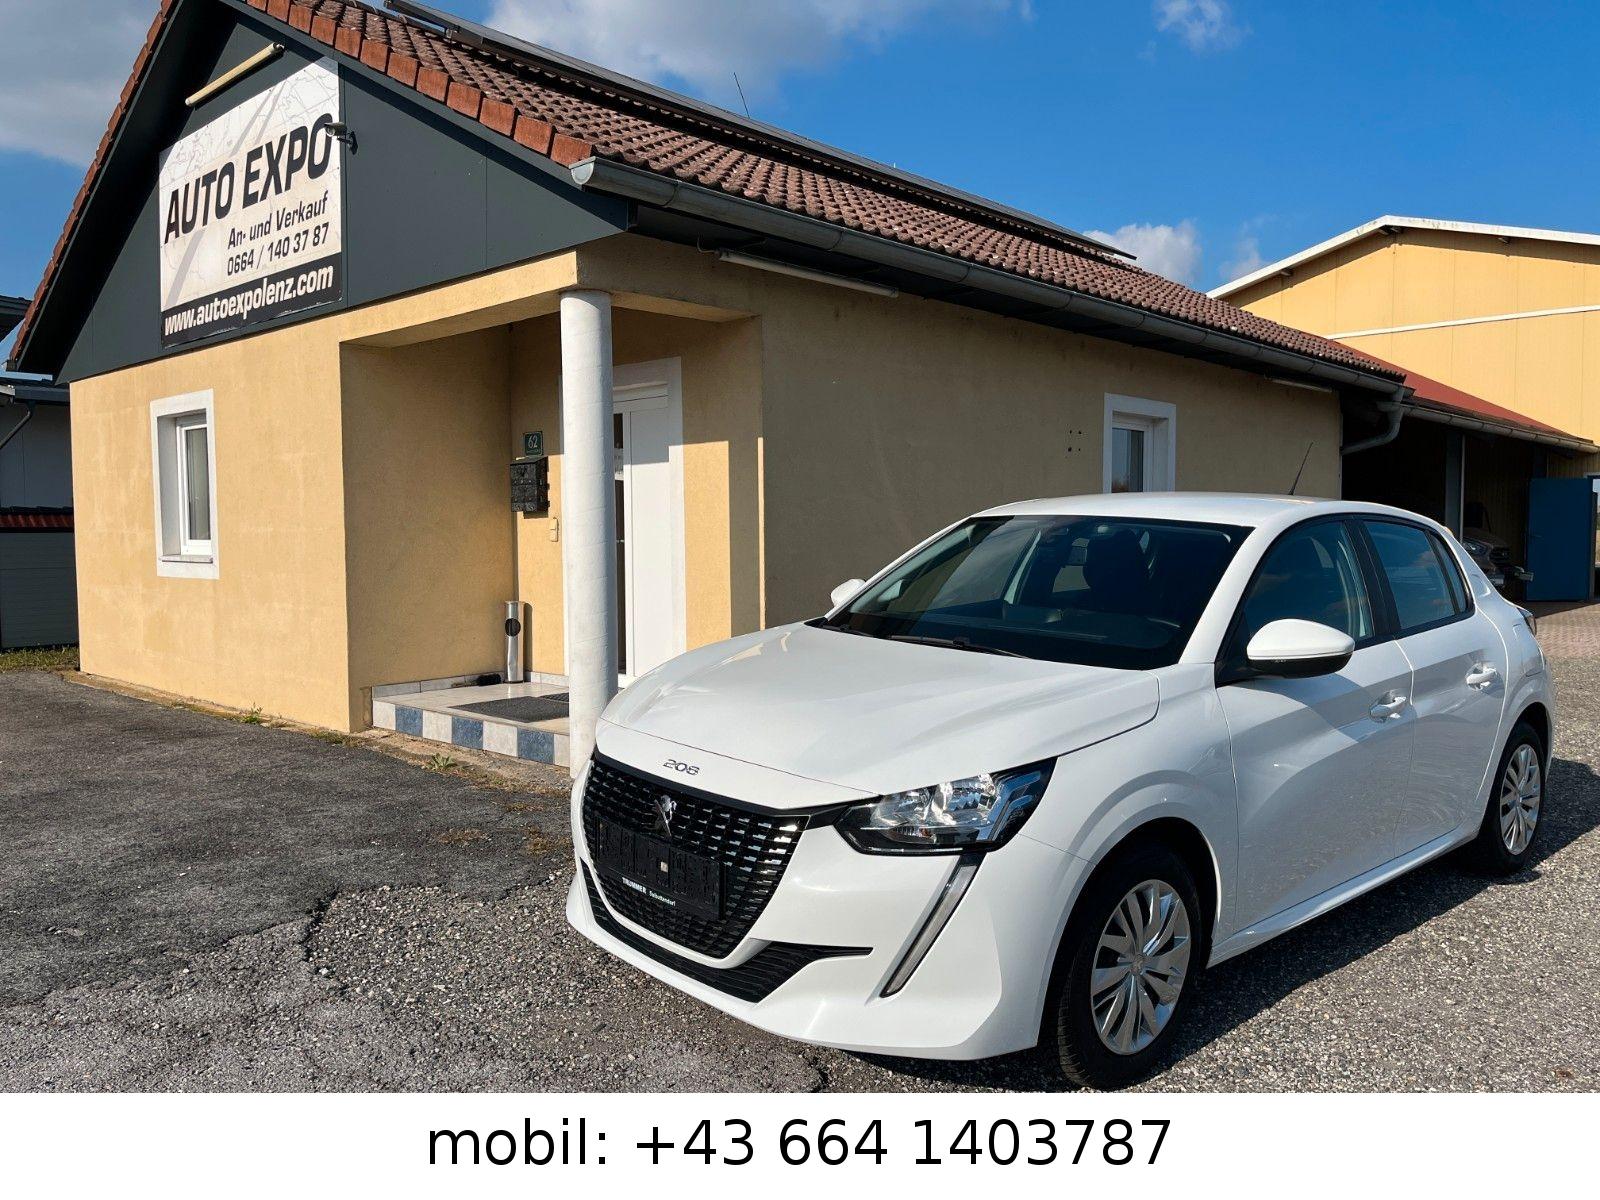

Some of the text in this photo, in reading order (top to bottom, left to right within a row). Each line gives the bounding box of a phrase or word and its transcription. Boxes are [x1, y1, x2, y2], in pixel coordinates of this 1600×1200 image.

[164, 112, 333, 245] AUTO EXPO
[228, 189, 328, 249] An- und Verkauf
[227, 222, 330, 276] 0664 / 140 37 87
[164, 264, 334, 336] www.autoexpolenz.com
[527, 434, 538, 449] 62
[662, 758, 700, 776] 208
